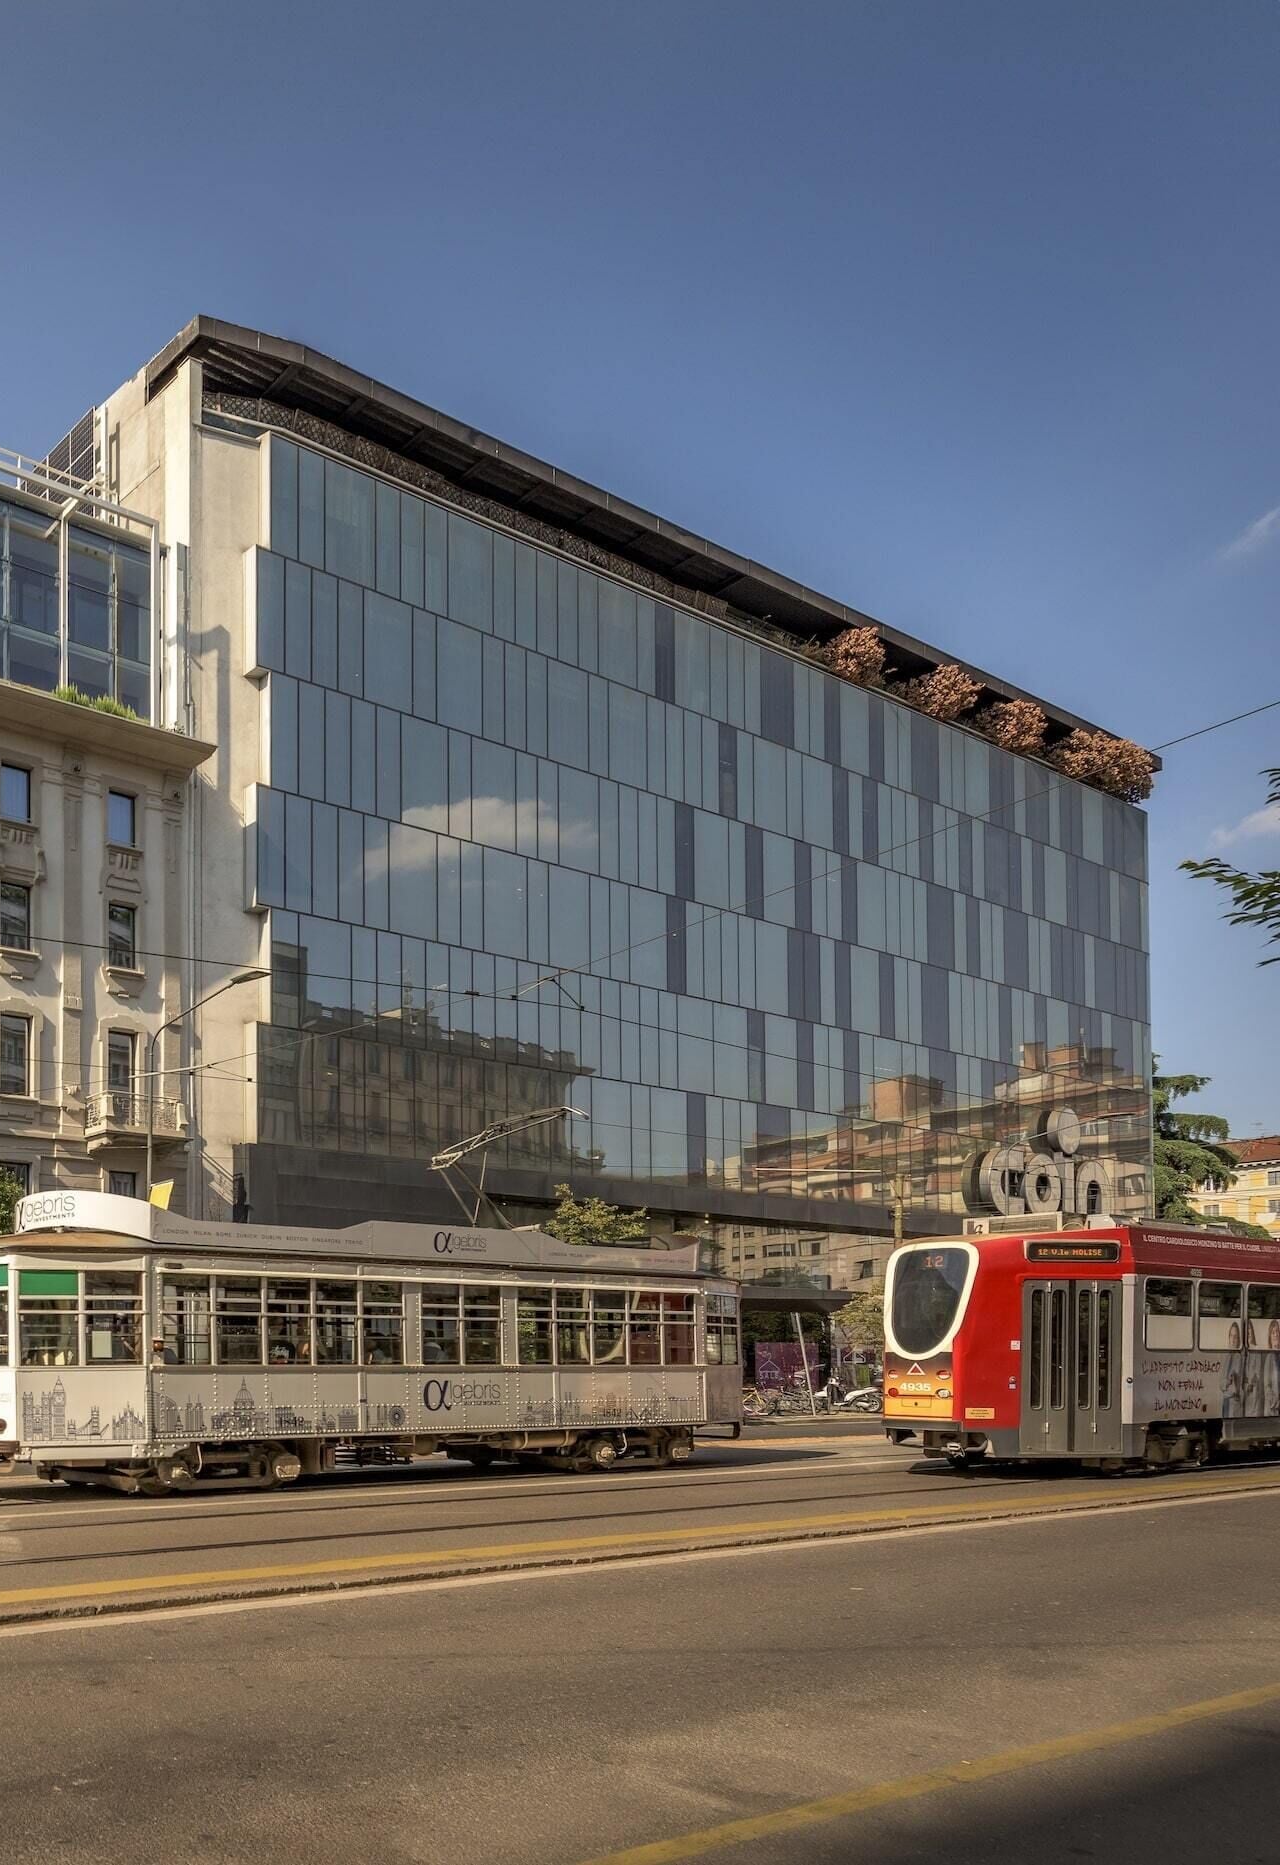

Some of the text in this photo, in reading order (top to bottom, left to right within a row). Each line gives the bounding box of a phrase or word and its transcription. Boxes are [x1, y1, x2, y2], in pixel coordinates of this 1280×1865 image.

[1037, 1248, 1103, 1256] 12 V.le MOLISE
[925, 1255, 944, 1268] 12
[900, 1382, 932, 1392] 4935
[1158, 1380, 1176, 1391] NON
[279, 1416, 305, 1428] 1842
